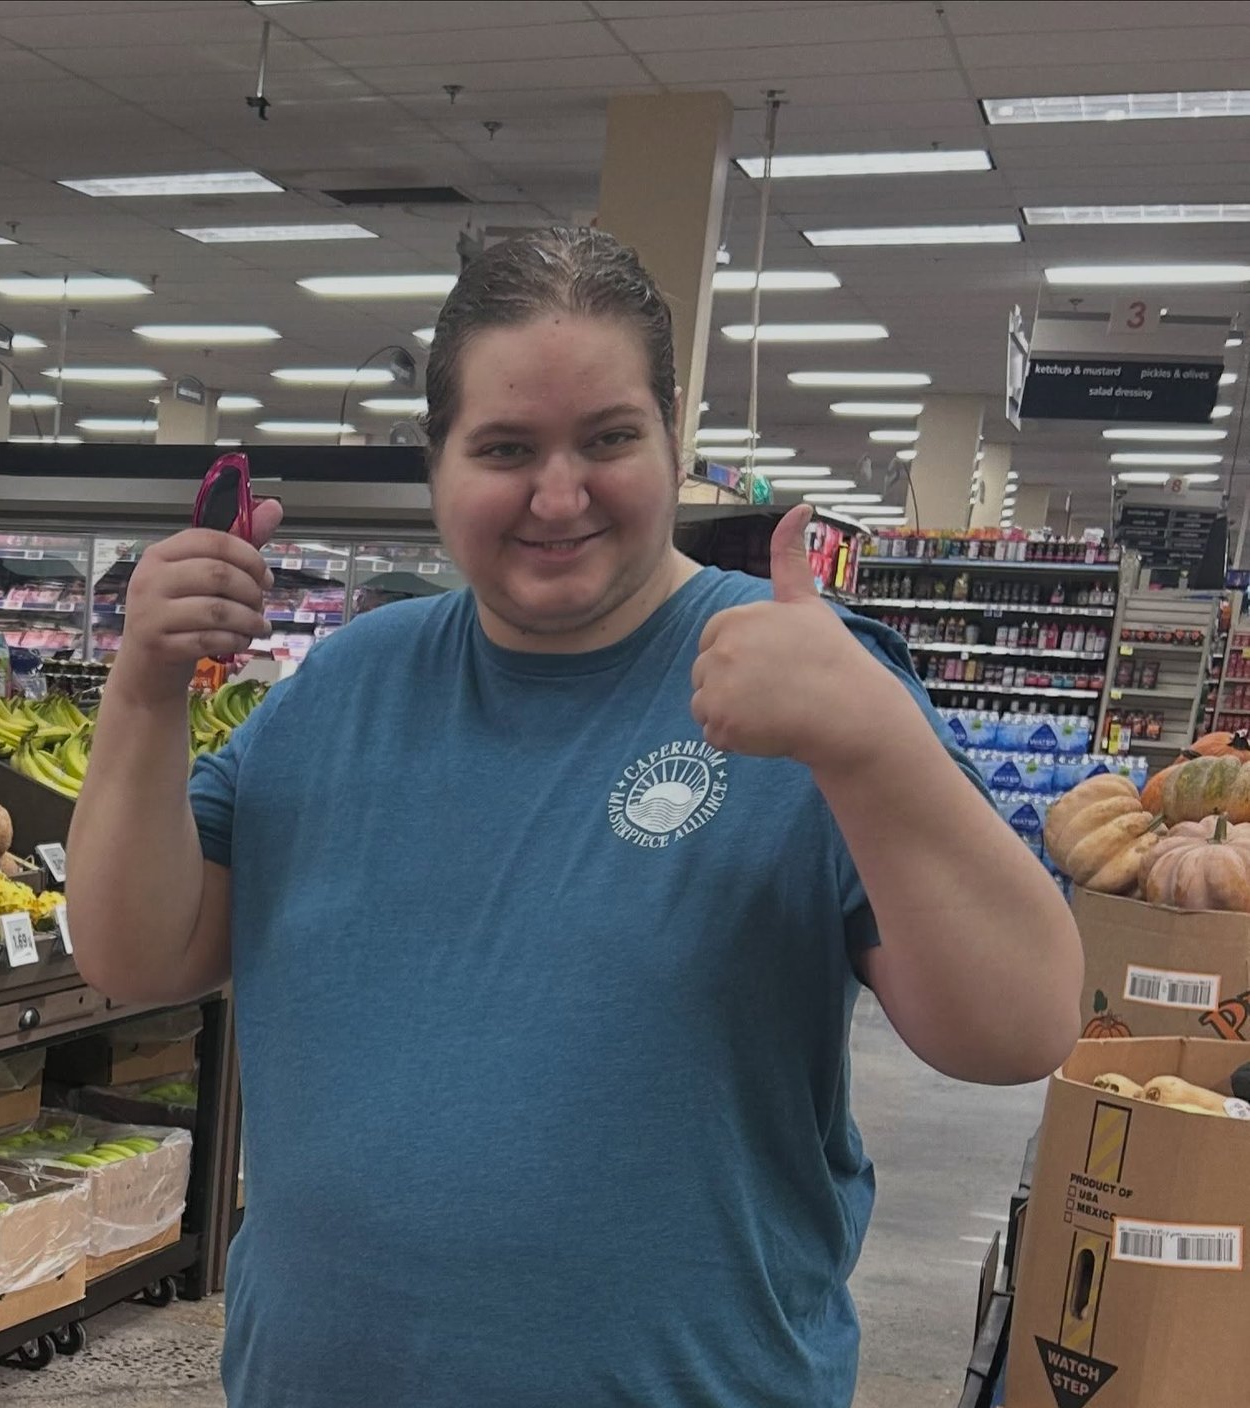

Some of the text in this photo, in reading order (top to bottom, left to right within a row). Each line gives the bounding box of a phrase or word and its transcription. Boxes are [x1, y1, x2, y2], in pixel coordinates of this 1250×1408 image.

[1126, 301, 1147, 329] 3
[1034, 365, 1122, 377] ketchup & mustard
[1140, 368, 1210, 380] pickles & olives
[1088, 387, 1153, 400] salad dressing
[623, 740, 727, 781] CAPERNAUM
[607, 781, 728, 849] MASTERPIECE ALLIANCE
[1070, 1172, 1133, 1199] PRODUCT OF
[1079, 1189, 1099, 1203] USA
[1047, 1349, 1100, 1382] WATCH
[1052, 1372, 1090, 1396] STEP
